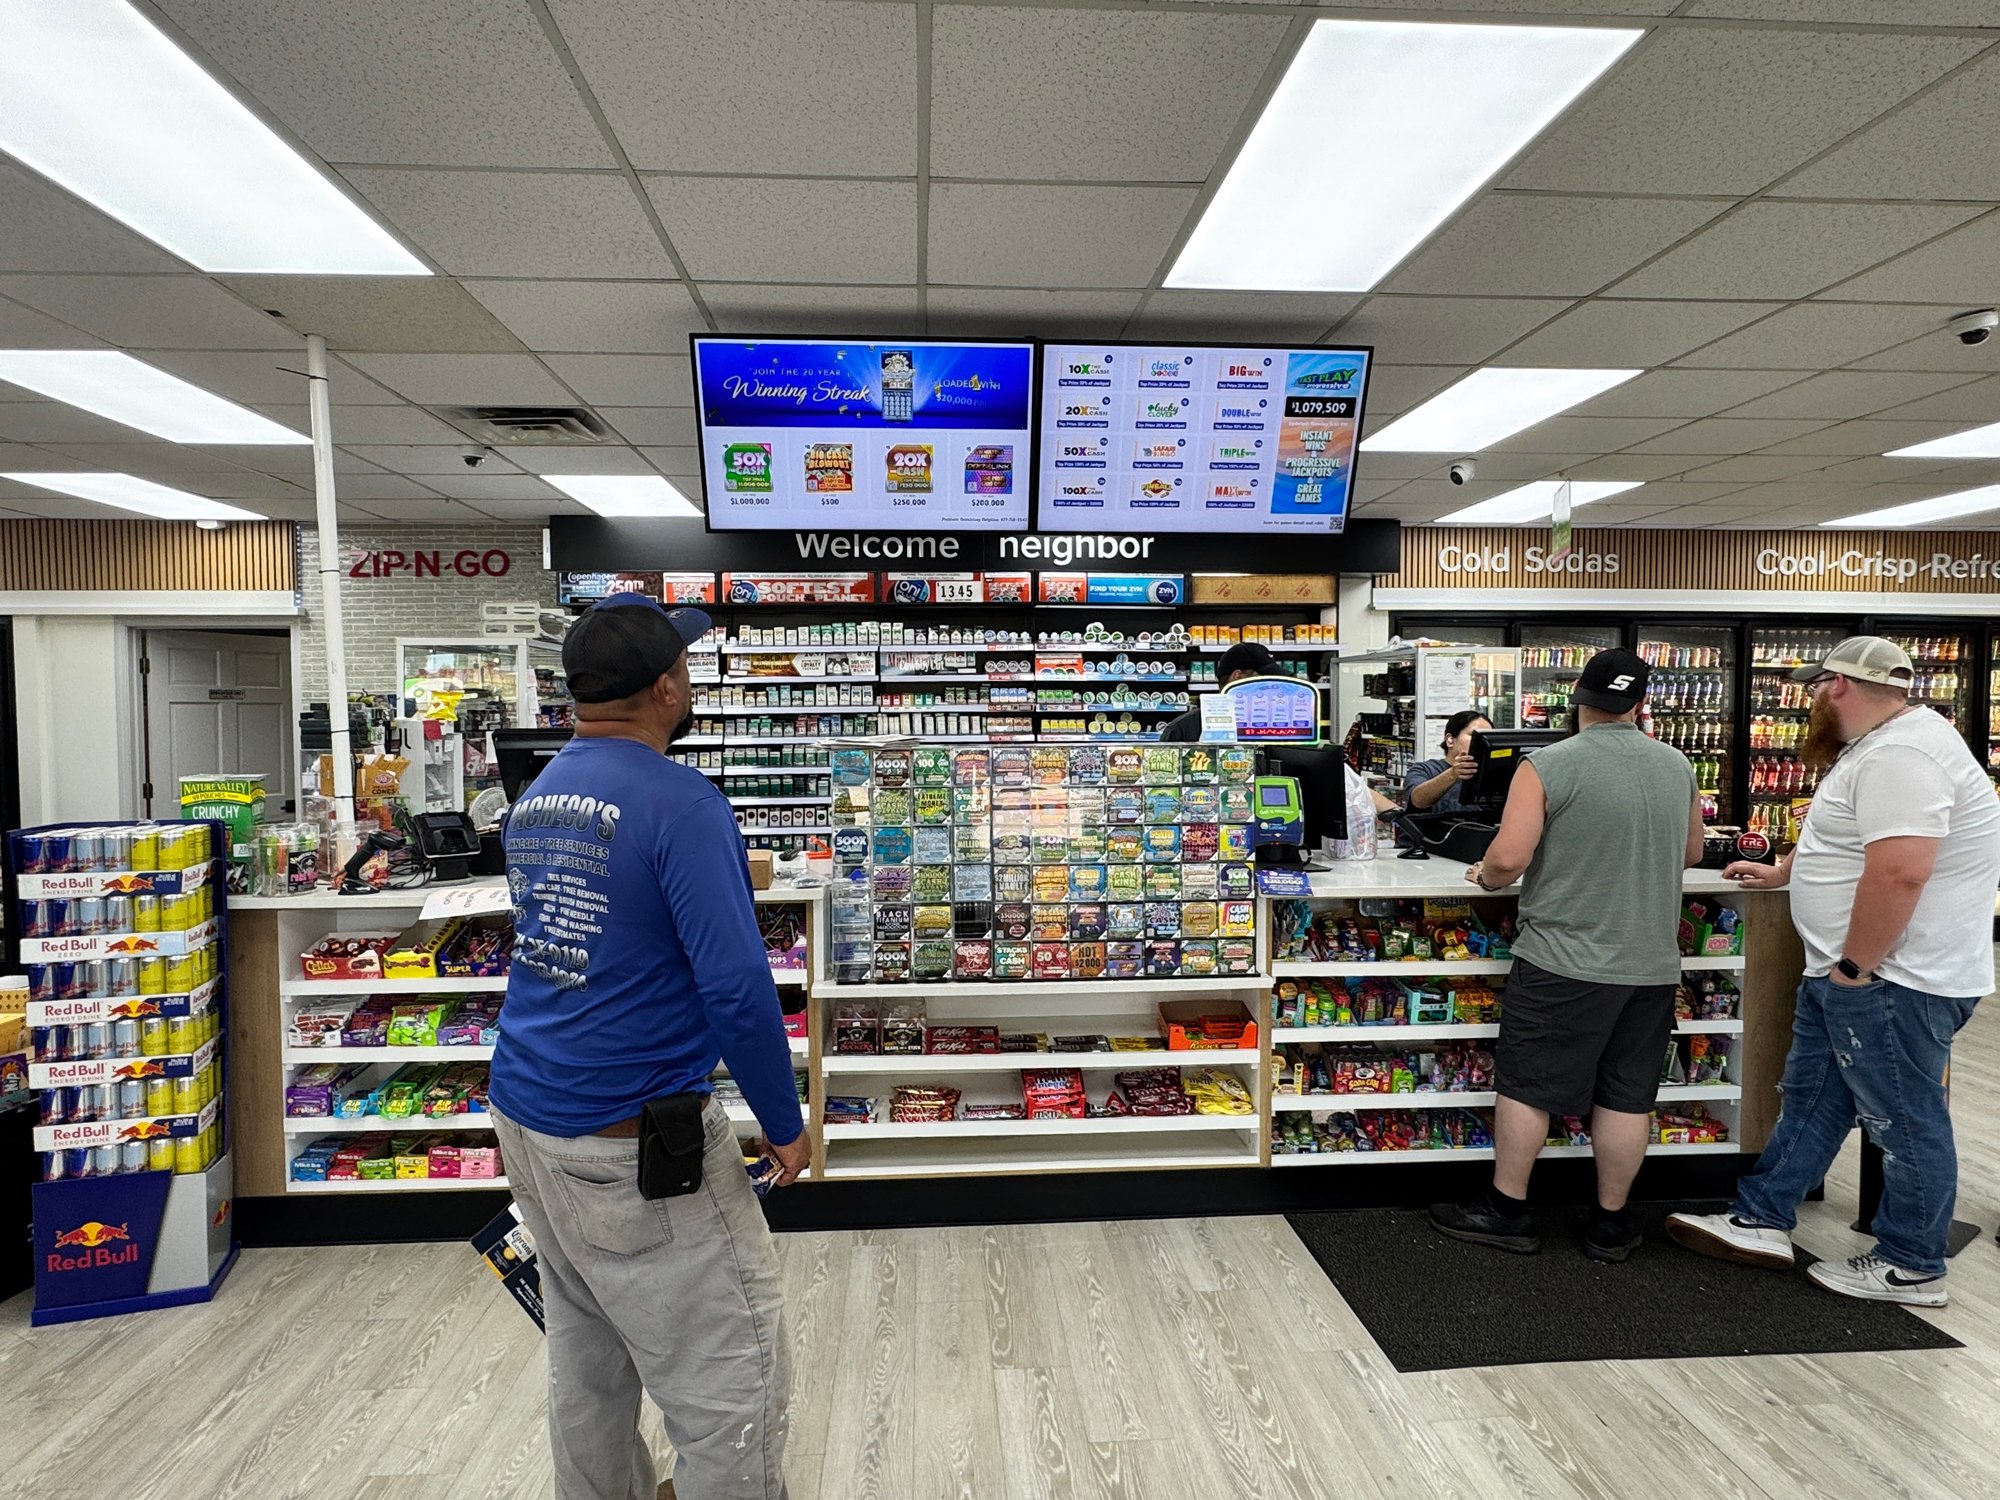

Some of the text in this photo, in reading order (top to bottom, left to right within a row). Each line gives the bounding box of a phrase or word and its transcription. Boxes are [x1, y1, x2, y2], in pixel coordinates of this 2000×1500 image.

[1069, 364, 1090, 374] 10X
[1151, 360, 1180, 371] classic
[752, 368, 841, 376] JOIN THE 20 YEAR
[1229, 366, 1247, 376] BIG
[1319, 368, 1356, 382] PLAY
[939, 379, 973, 388] LOADED
[723, 375, 871, 405] Winning Streak
[1066, 406, 1088, 416] 20X
[1154, 403, 1179, 416] lucky
[1222, 408, 1250, 417] DOUBLE
[1292, 402, 1347, 414] $1,079,509
[1300, 430, 1334, 440] INSTANT
[1305, 440, 1326, 450] WINS
[826, 450, 850, 460] CASH
[1064, 446, 1087, 456] 50X
[1220, 448, 1246, 458] TRIPLE
[732, 452, 767, 466] 50X
[893, 452, 927, 467] 20X
[1286, 458, 1340, 468] PROGRESSIVE
[808, 460, 850, 469] BLOWOUT
[736, 466, 765, 476] CASH
[896, 466, 925, 476] CASH
[1292, 468, 1332, 476] JACKPOTS
[1062, 487, 1087, 495] 100X
[1297, 484, 1323, 494] GREAT
[730, 498, 770, 506] $1,000,000
[820, 498, 840, 506] $500
[892, 498, 926, 506] $250,000
[1294, 494, 1322, 503] GAMES
[795, 533, 1155, 566] Welcome neighbor
[1438, 546, 1620, 575] Cold Sodas
[568, 572, 619, 583] Copenhagen
[606, 580, 644, 594] 250TH
[757, 582, 855, 594] SOFTEST
[760, 594, 868, 602] POUCH PLANET
[1114, 755, 1139, 765] 20X
[1150, 754, 1173, 763] CASH
[876, 760, 907, 768] 200X
[183, 782, 247, 795] NATURE VALLEY
[192, 805, 240, 820] CRUNCHY
[511, 794, 621, 842] ACHECO'S
[836, 836, 866, 845] 500X
[1742, 838, 1764, 847] FRE
[562, 838, 610, 860] SERVICES
[1114, 871, 1136, 879] CASH
[1227, 868, 1249, 879] 10X
[42, 877, 93, 890] Red Bull
[562, 874, 586, 887] SERVICES
[1114, 879, 1136, 887] KING
[999, 882, 1023, 890] VAULT
[576, 888, 610, 903] REMOVAL
[576, 900, 610, 914] REMOVAL
[1229, 904, 1249, 914] CASH
[876, 910, 908, 918] BLACK
[1229, 914, 1250, 924] DROP
[569, 920, 602, 934] WASHING
[41, 938, 96, 953] Red Bull
[876, 952, 908, 960] 200X
[1079, 946, 1096, 957] HOT
[445, 965, 472, 973] SUPER
[44, 1002, 100, 1016] Red Bull
[49, 1064, 104, 1078] Red Bull
[1040, 1080, 1066, 1089] mega
[1348, 1079, 1380, 1090] SODA CAN
[53, 1124, 109, 1140] Red Bull
[47, 1243, 138, 1273] Red Bull
